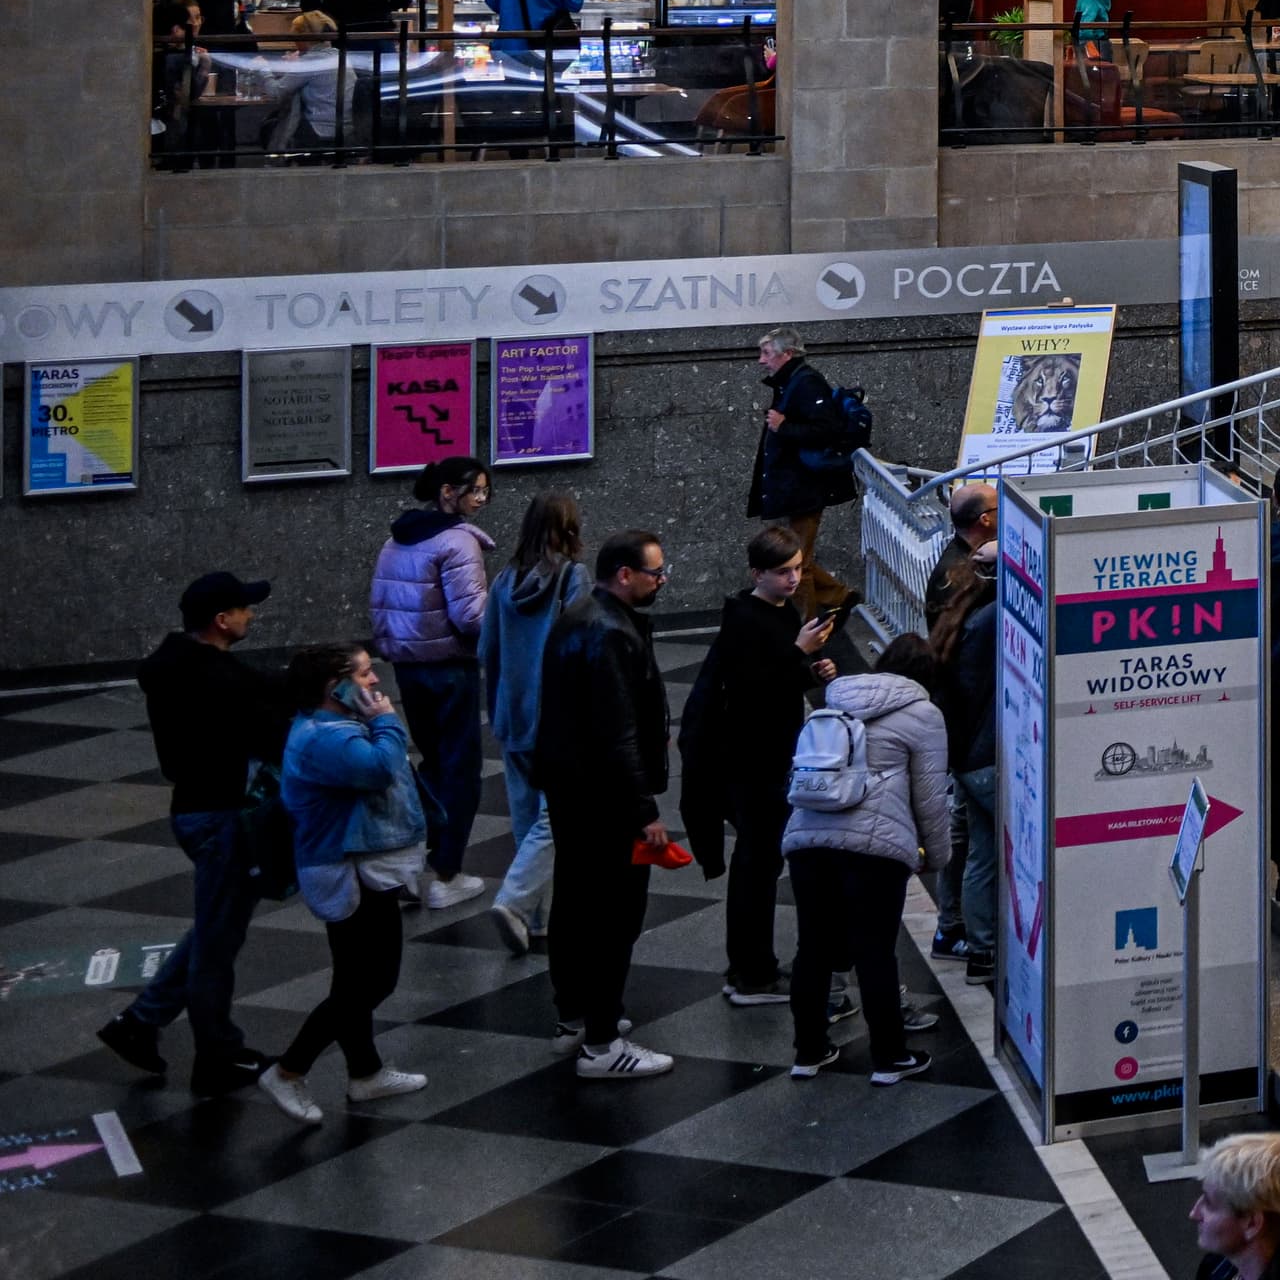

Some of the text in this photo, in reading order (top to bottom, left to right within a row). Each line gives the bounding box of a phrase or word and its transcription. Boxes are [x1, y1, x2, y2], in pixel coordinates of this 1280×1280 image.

[894, 261, 1061, 300] POCZTA
[600, 272, 792, 313] SZATNIA
[255, 285, 491, 330] TOALETY
[502, 345, 579, 358] ART FACTOR
[1021, 337, 1070, 352] WHY?
[32, 368, 79, 381] TARAS
[387, 378, 459, 396] KASA
[38, 404, 74, 423] 30.
[1094, 550, 1198, 573] VIEWING
[1094, 568, 1197, 590] TERRACE
[1120, 653, 1193, 675] TARAS
[1087, 667, 1227, 695] WIDOKOWY
[1113, 694, 1202, 710] SELF-SERVICE LIFT
[795, 777, 828, 791] FILA
[1108, 821, 1128, 831] KASA
